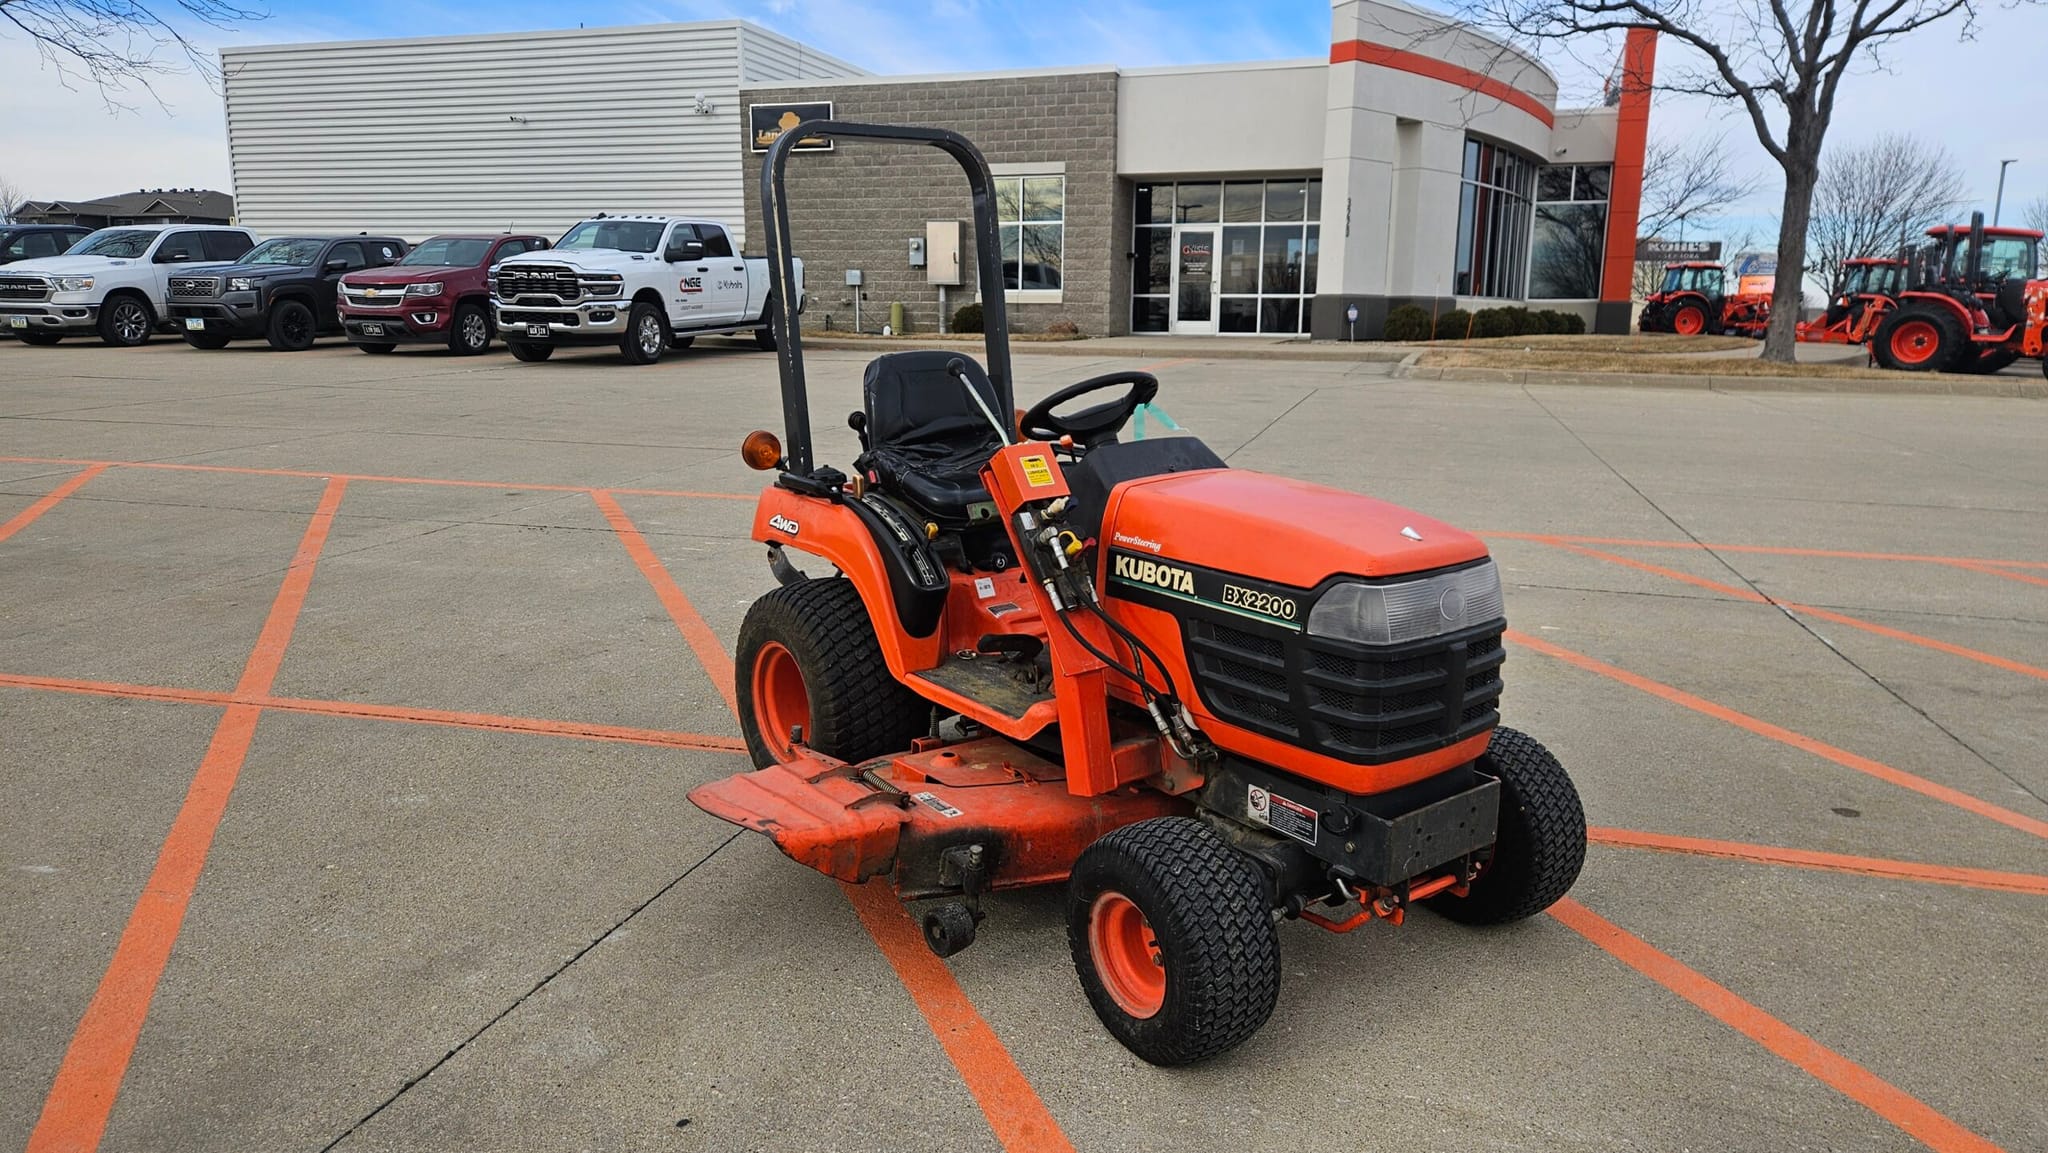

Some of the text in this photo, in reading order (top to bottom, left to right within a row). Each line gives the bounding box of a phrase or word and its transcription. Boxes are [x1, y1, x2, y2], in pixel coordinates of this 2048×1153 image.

[515, 271, 555, 279] RAM
[769, 514, 799, 535] 4WD
[1114, 532, 1162, 553] PowerSteering
[1115, 554, 1195, 595] KUBOTA
[1222, 583, 1296, 620] BX2200
